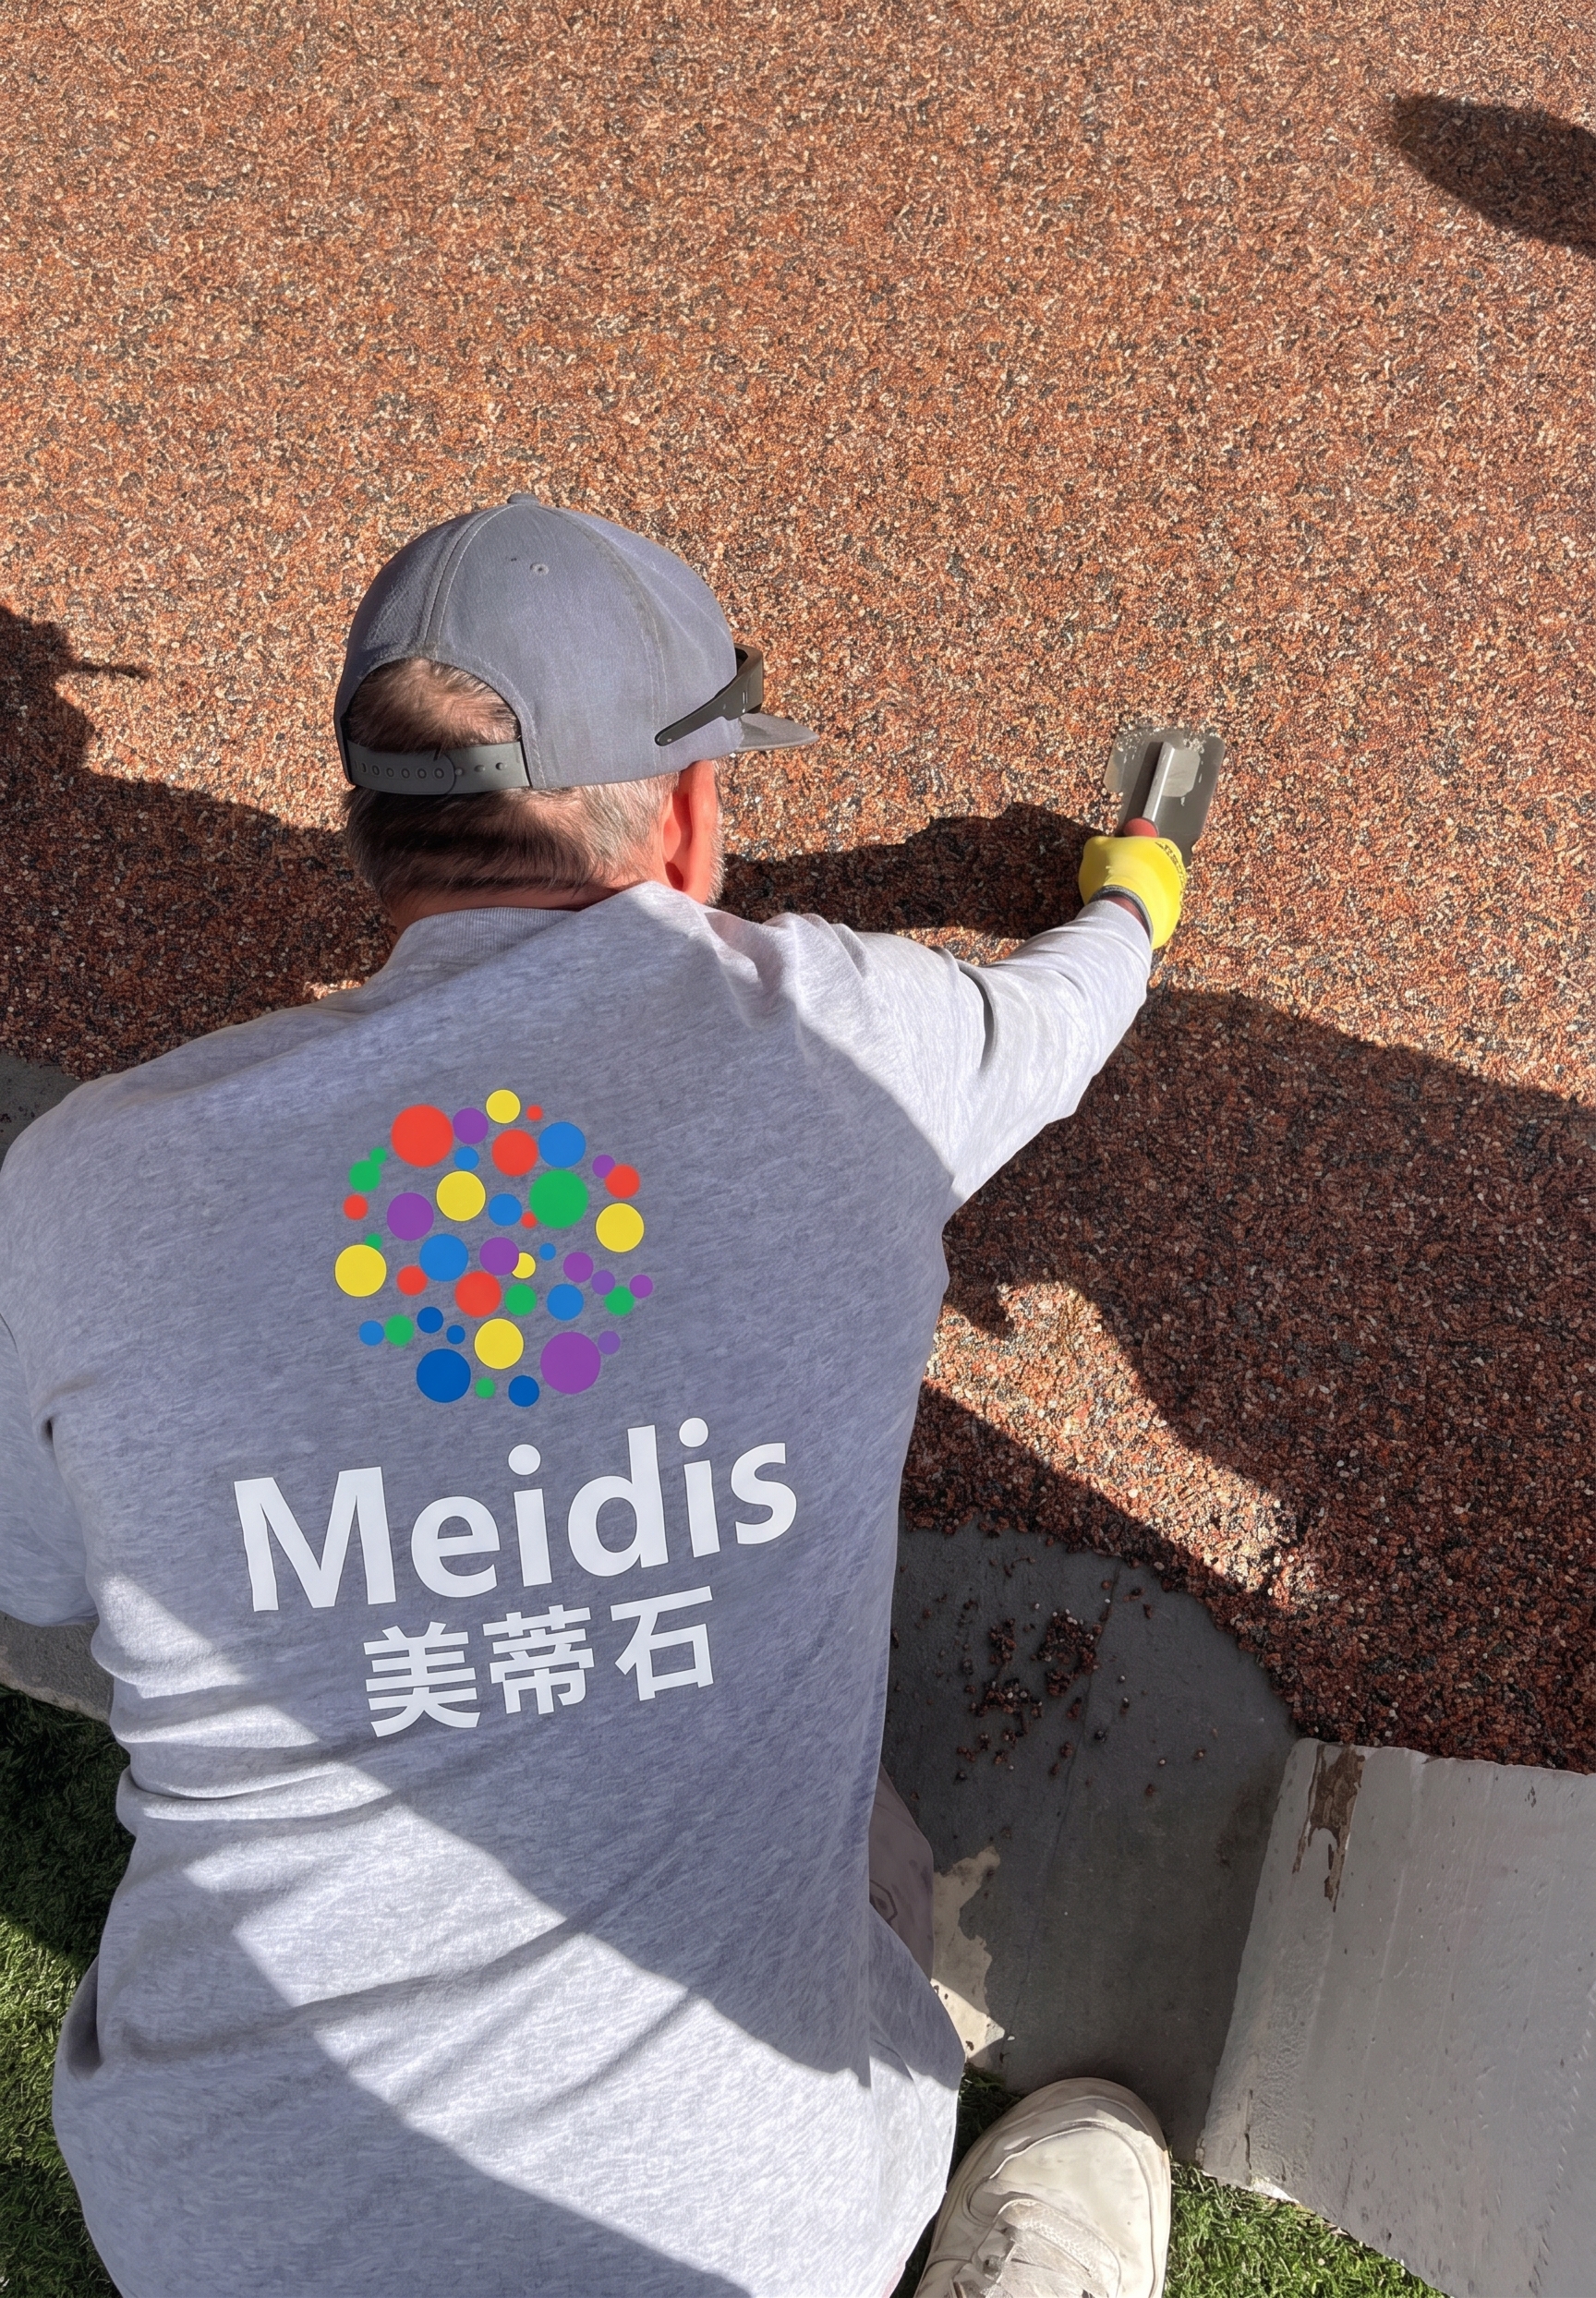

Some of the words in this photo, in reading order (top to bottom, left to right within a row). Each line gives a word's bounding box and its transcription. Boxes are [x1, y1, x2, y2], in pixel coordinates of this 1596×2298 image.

[234, 1417, 797, 1612] Meidis
[363, 1585, 714, 1737] 美蒂石
